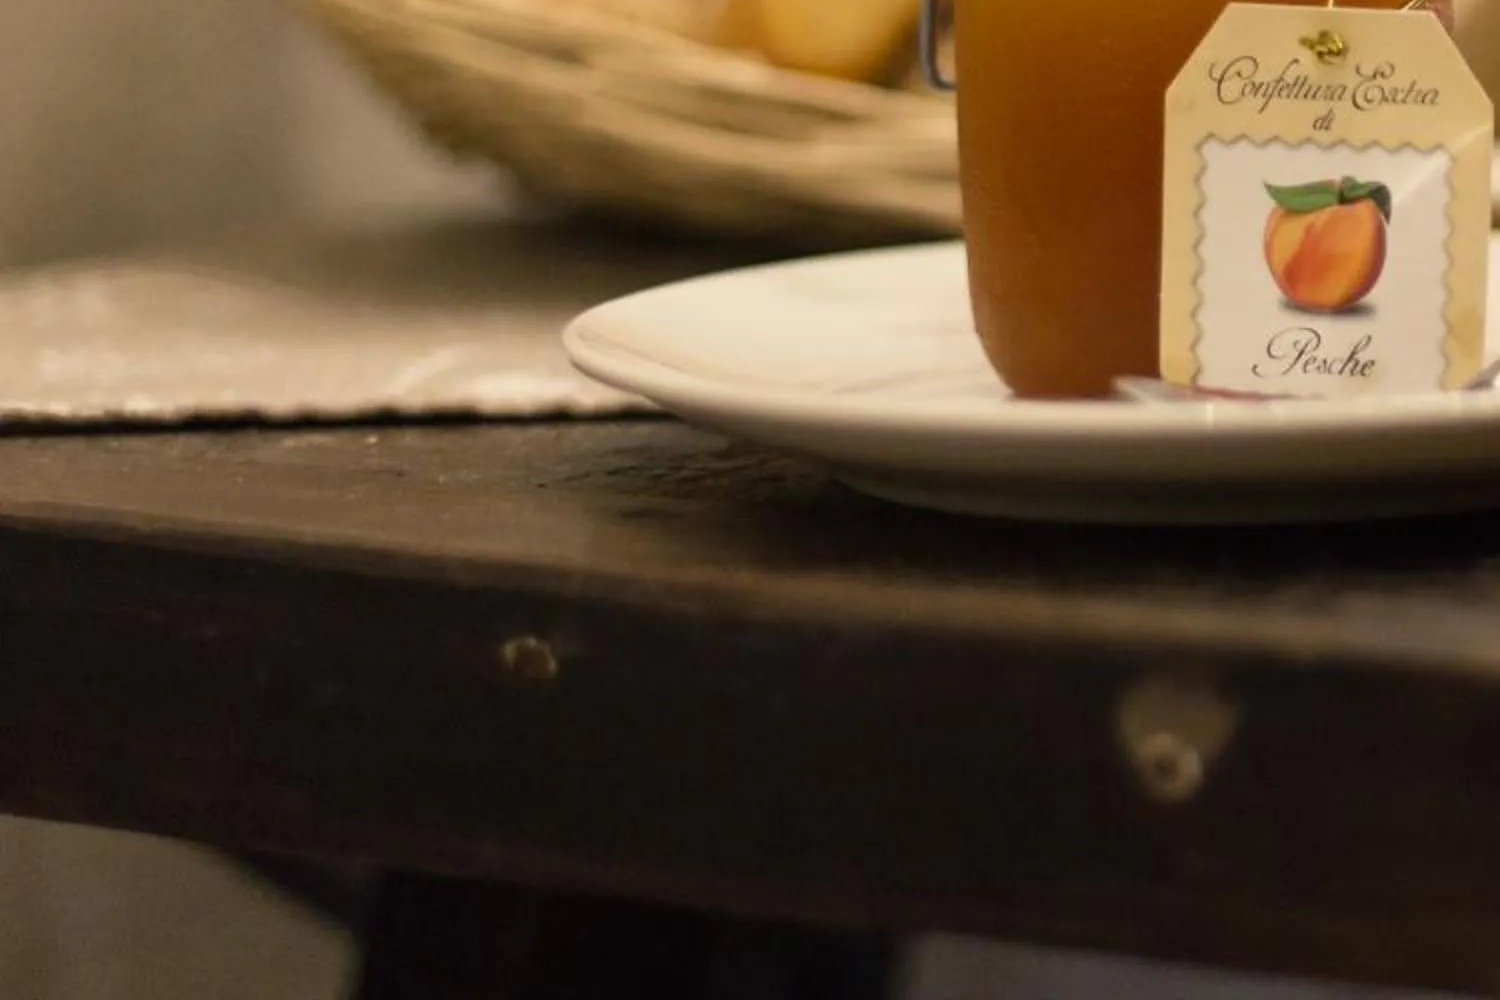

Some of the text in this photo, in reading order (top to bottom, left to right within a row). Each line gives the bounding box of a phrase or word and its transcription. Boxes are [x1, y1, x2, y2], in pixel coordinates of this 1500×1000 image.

[1208, 55, 1440, 114] Confettura Extra
[1312, 103, 1336, 132] di
[1251, 326, 1376, 379] Pesche
